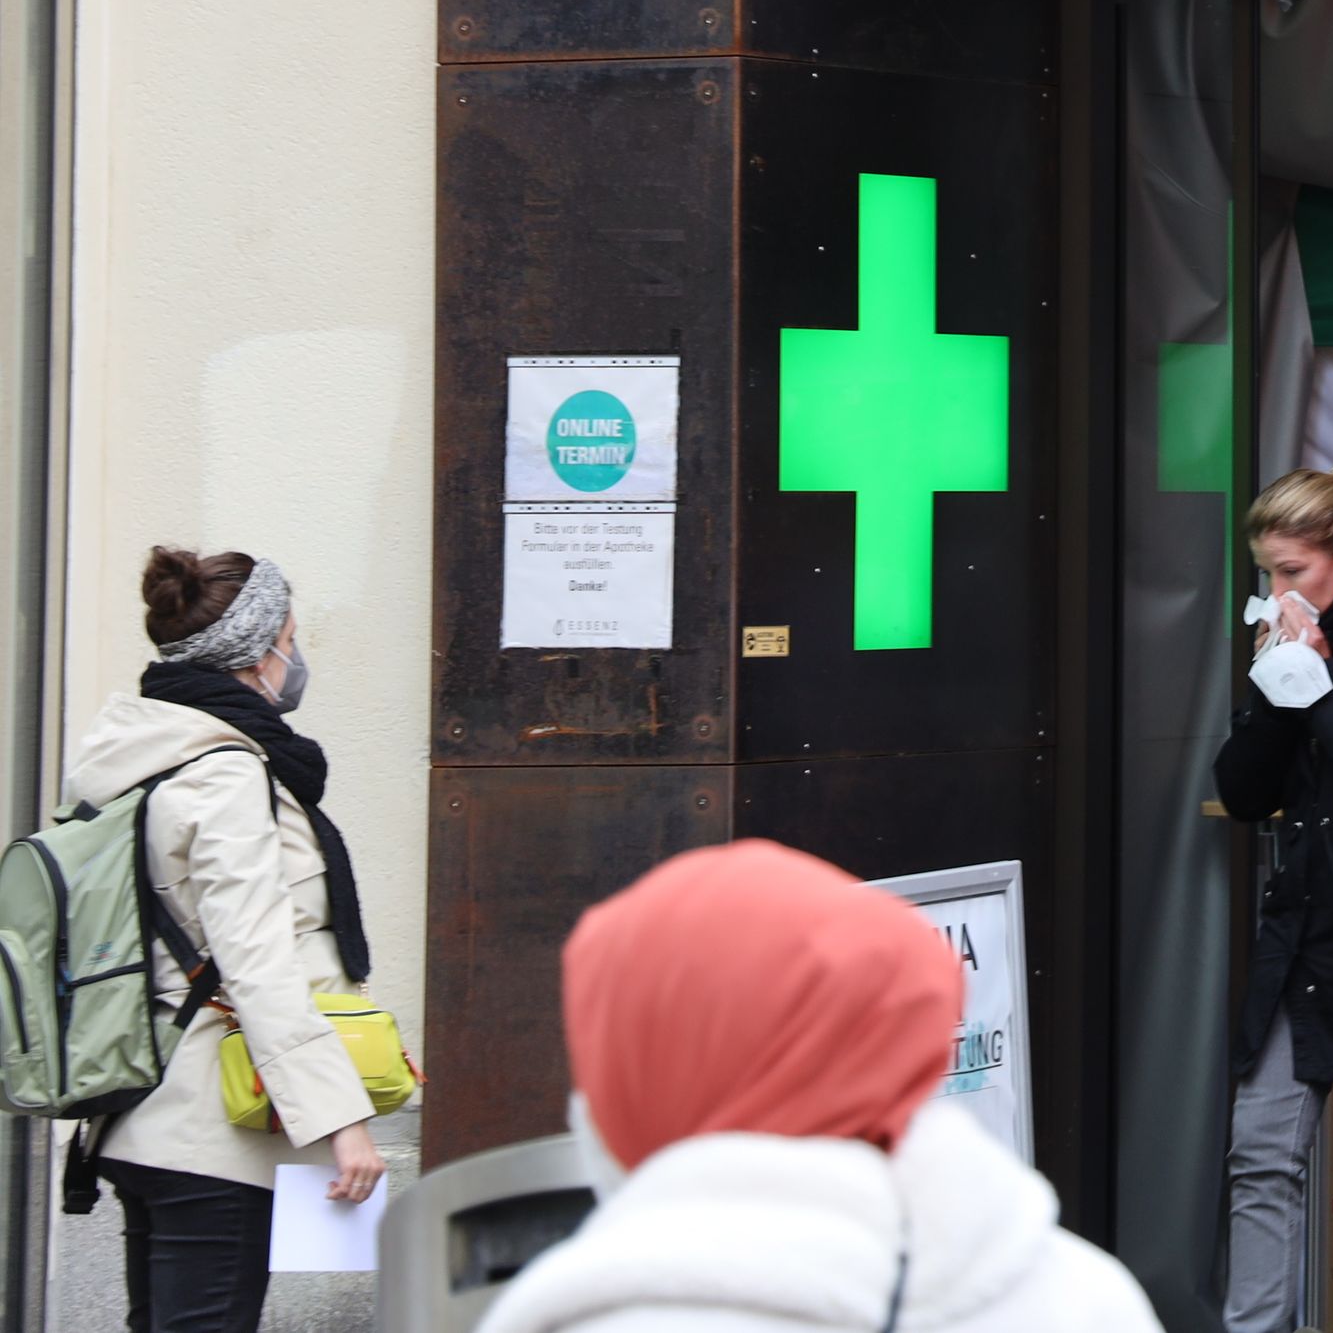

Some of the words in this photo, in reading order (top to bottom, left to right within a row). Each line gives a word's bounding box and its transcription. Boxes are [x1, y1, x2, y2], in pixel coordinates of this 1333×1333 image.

[556, 419, 623, 437] ONLINE
[556, 446, 627, 465] TERMIN
[534, 522, 559, 535] Bitte
[562, 524, 578, 534] vor
[581, 523, 599, 535] der
[602, 522, 643, 537] Testung
[521, 539, 568, 552] Formular
[571, 541, 580, 552] in
[583, 541, 601, 552] der
[603, 541, 654, 553] Apotheke
[568, 579, 608, 592] Danke!
[568, 620, 619, 631] ESSENZ
